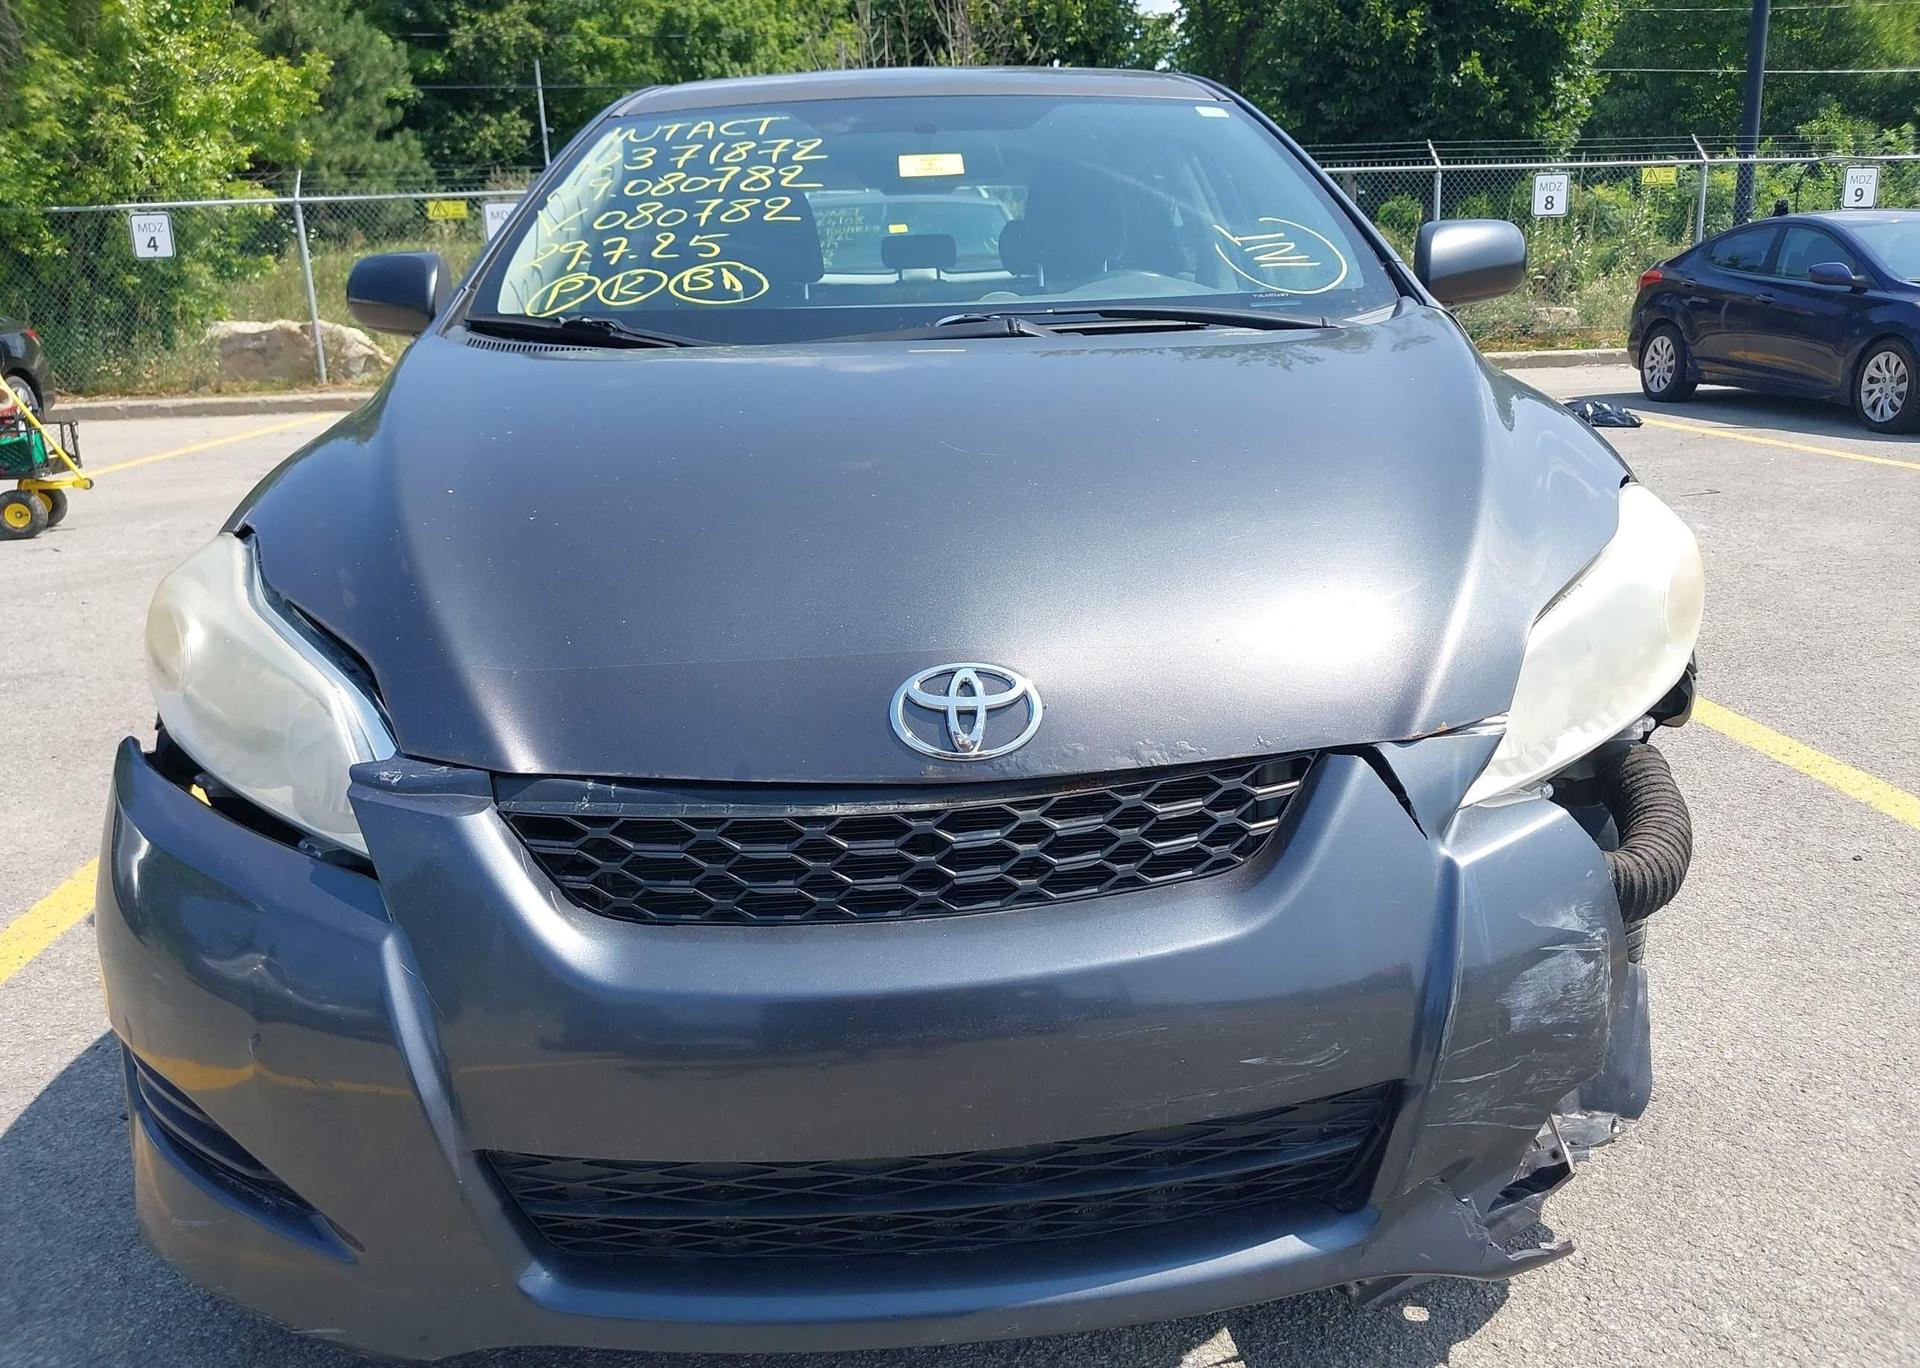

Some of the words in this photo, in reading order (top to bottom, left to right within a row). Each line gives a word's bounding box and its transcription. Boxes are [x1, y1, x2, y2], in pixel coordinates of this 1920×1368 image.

[1849, 174, 1873, 185] MDZ
[1539, 181, 1563, 192] MDZ
[1853, 187, 1865, 203] 9
[1544, 195, 1555, 211] 8
[137, 222, 164, 233] MDZ
[146, 236, 160, 252] 4
